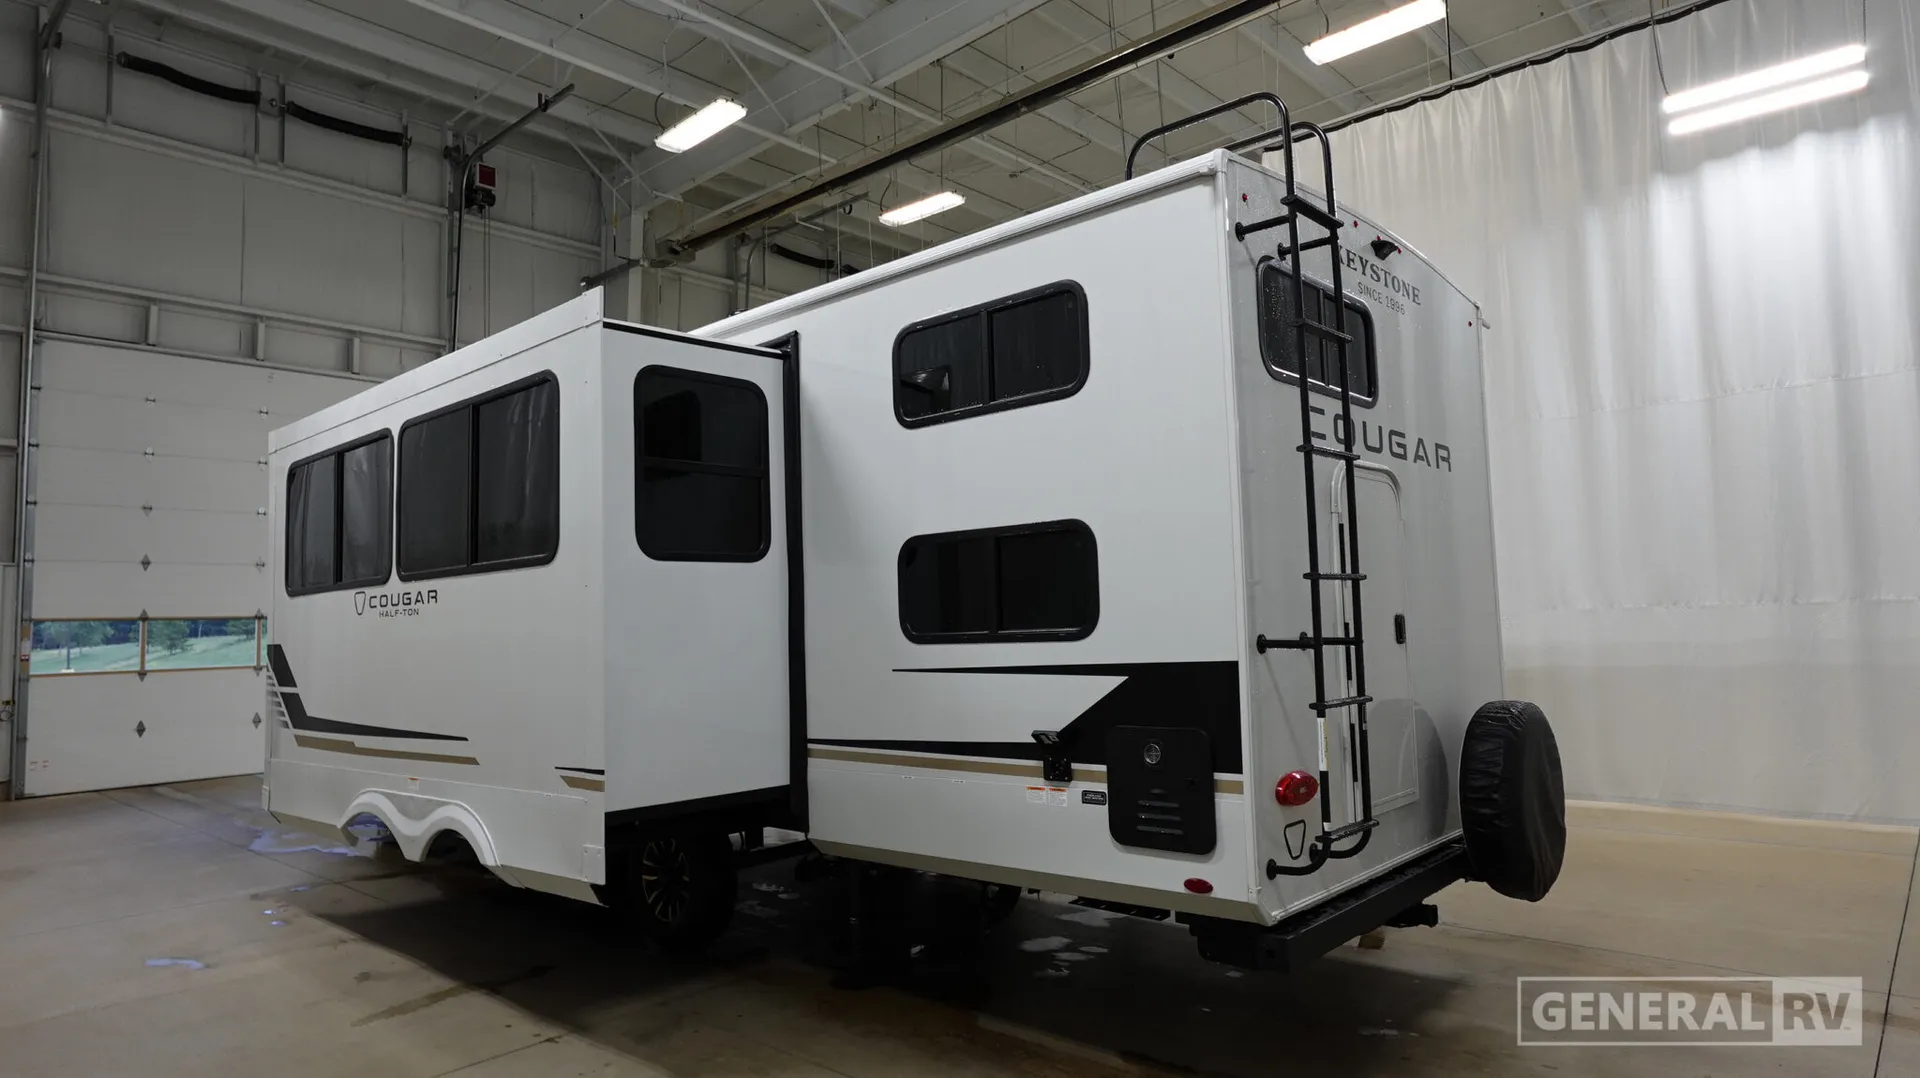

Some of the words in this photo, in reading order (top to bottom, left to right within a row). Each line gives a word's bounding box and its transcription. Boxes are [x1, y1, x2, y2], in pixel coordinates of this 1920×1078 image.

[1357, 281, 1383, 304] SINCE
[368, 589, 438, 609] COUGAR
[379, 607, 420, 618] HALF-TON
